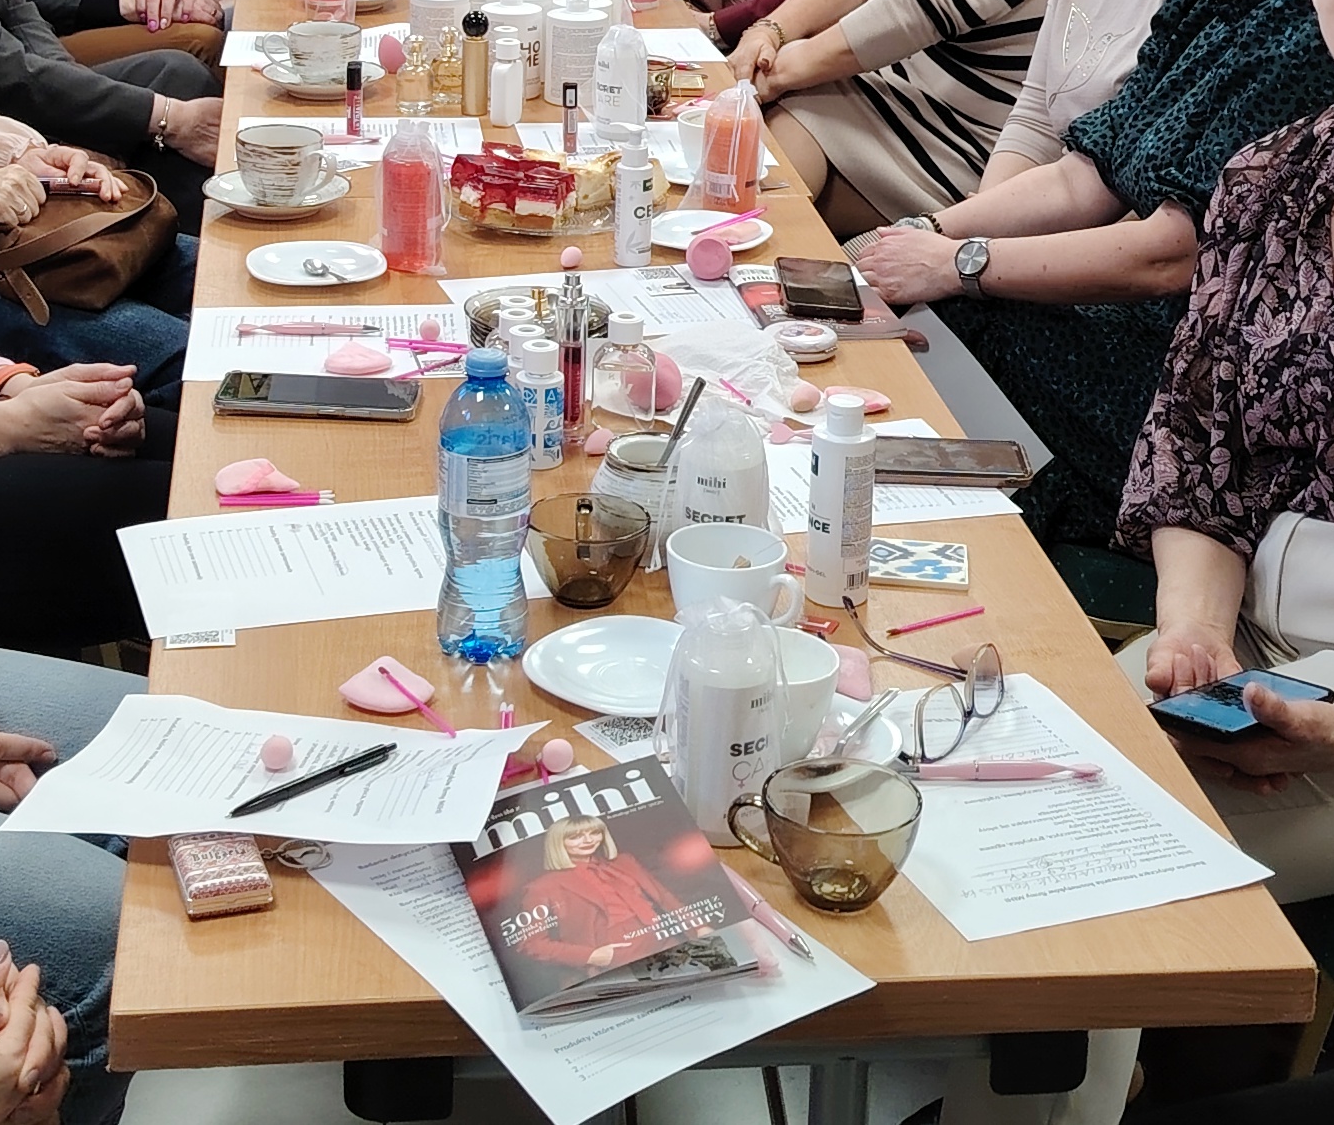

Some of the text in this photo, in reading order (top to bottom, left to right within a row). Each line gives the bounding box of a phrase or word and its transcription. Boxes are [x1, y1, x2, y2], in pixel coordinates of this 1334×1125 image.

[697, 476, 727, 489] mihi
[470, 769, 665, 862] mihi
[623, 901, 723, 941] szacunkiem do
[651, 898, 710, 923] stworzona
[653, 906, 727, 942] natury
